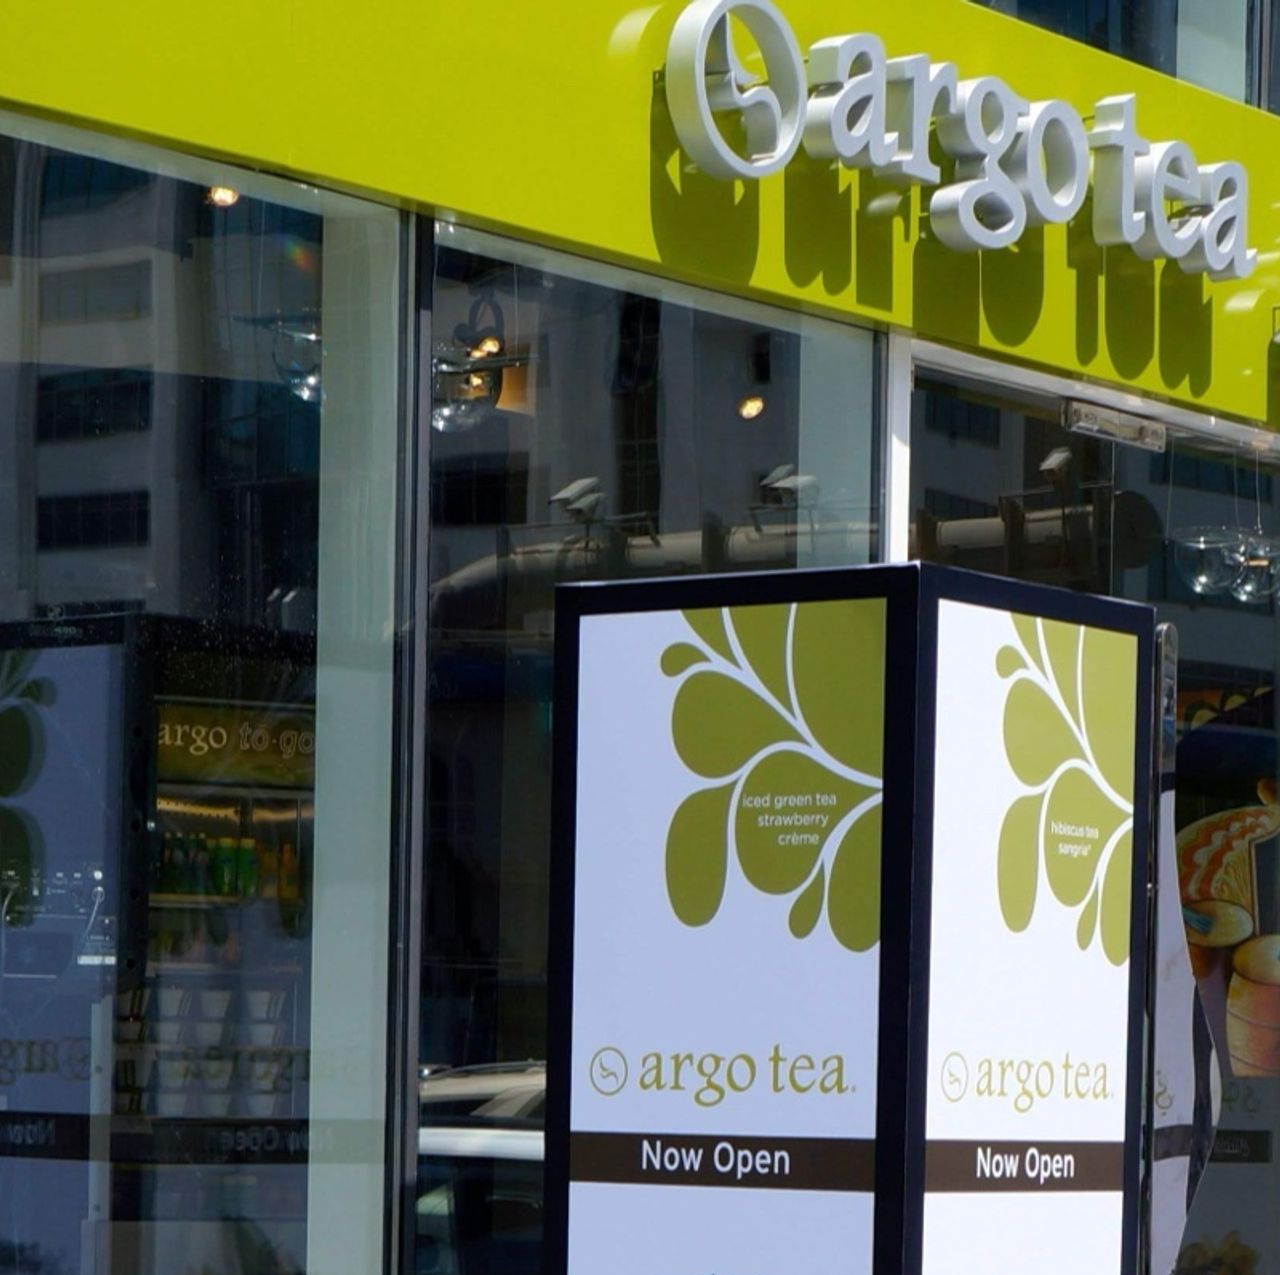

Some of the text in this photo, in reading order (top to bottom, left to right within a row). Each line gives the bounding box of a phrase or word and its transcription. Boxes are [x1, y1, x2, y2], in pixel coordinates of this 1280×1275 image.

[803, 34, 1257, 280] argo tea
[158, 723, 228, 756] argo
[742, 793, 837, 810] iced green tea
[757, 812, 829, 829] strawberry
[1051, 820, 1085, 838] hibiscus
[638, 1050, 758, 1107] argo
[975, 1057, 1055, 1113] argo
[641, 1139, 790, 1180] Now Open
[976, 1146, 1075, 1185] Now Open
